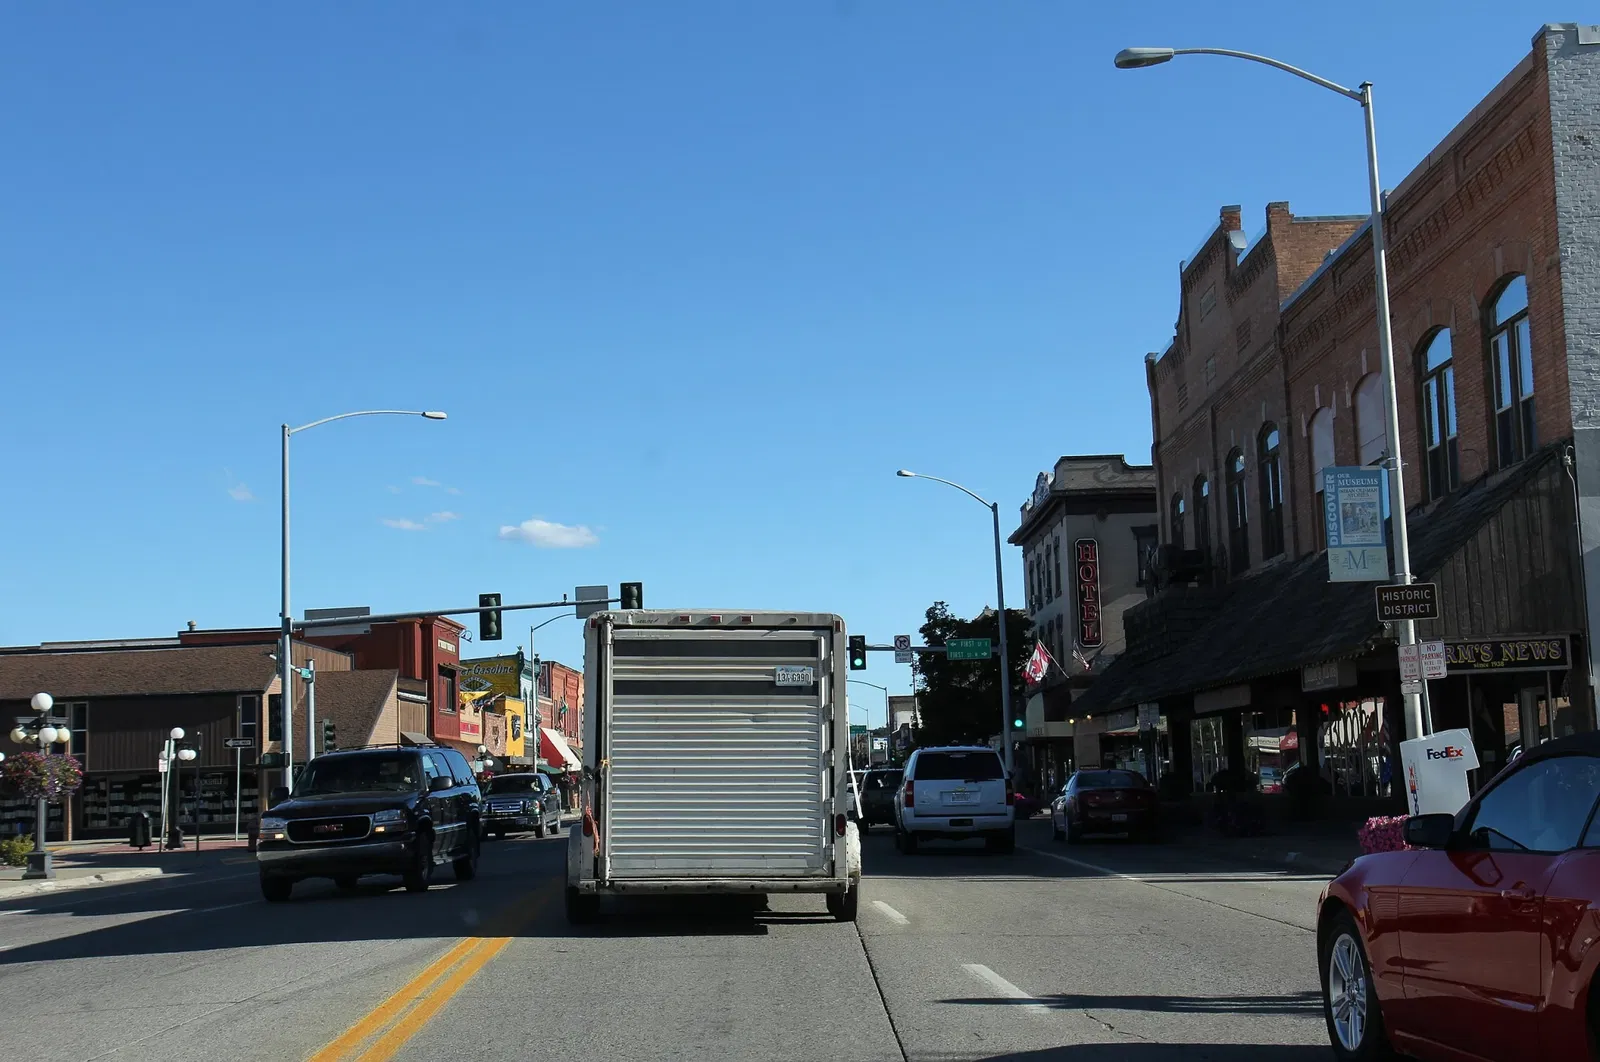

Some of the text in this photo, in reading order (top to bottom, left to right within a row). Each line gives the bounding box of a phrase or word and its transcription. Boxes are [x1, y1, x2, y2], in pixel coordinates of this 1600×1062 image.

[1337, 478, 1379, 487] MUSEUMS
[1325, 474, 1338, 546] DISCOVER
[1347, 549, 1368, 570] M
[1078, 544, 1099, 643] HOTEL
[1382, 589, 1431, 602] HISTORIC
[1384, 603, 1431, 615] DISTRICT
[1404, 647, 1412, 655] NO
[1426, 644, 1436, 652] NO
[1445, 640, 1562, 664] RM'S NEWS
[1421, 652, 1443, 660] PARKING
[460, 663, 514, 676] er Gasoline
[1426, 746, 1463, 760] FedEx
[1408, 766, 1420, 816] edEx
[314, 823, 343, 833] GMC
